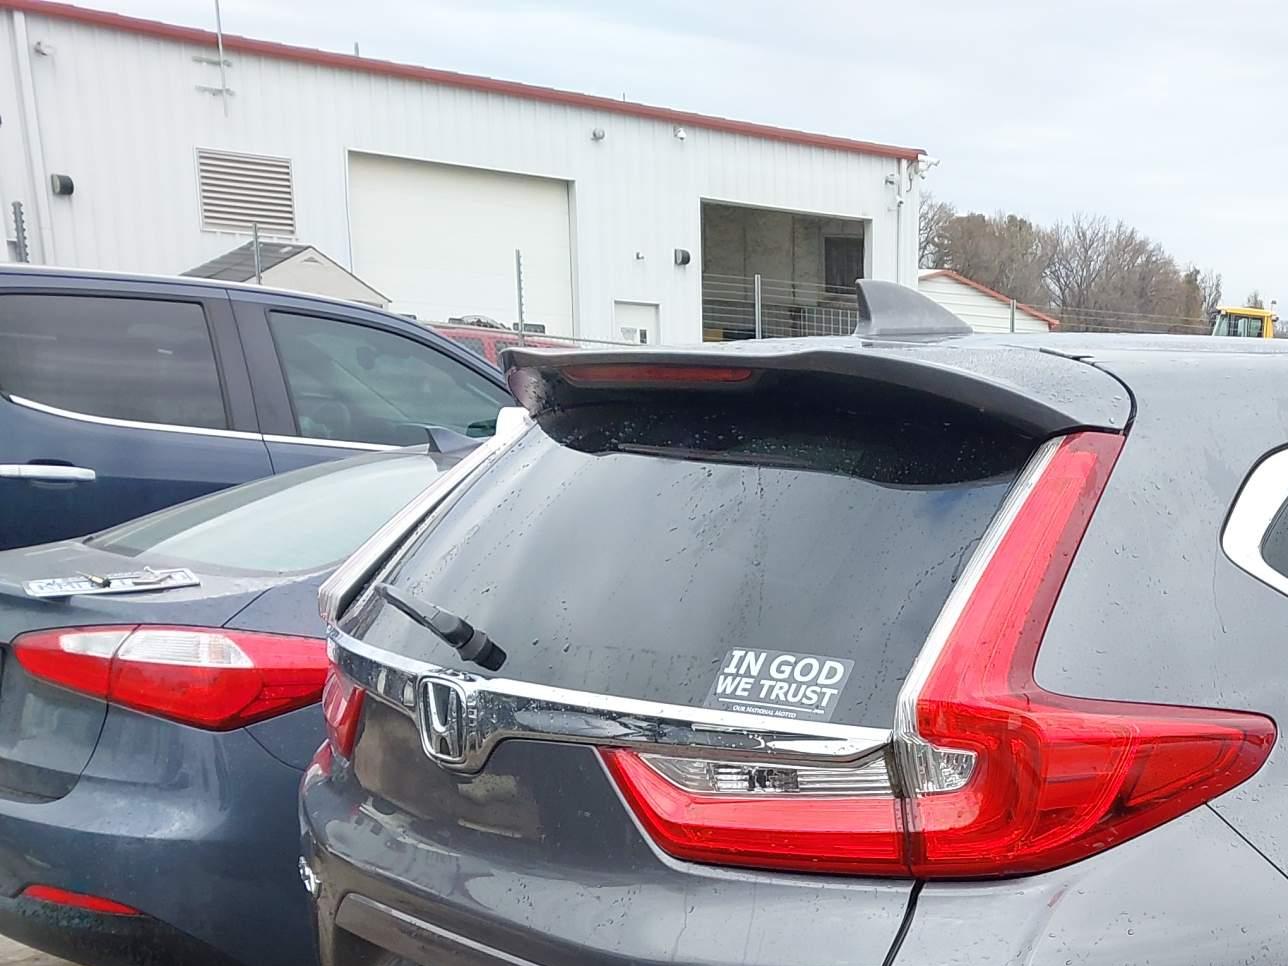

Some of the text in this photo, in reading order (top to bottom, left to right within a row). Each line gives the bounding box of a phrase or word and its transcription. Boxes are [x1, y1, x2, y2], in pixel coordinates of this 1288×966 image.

[724, 650, 845, 685] IN GOD
[716, 675, 839, 707] WE TRUST
